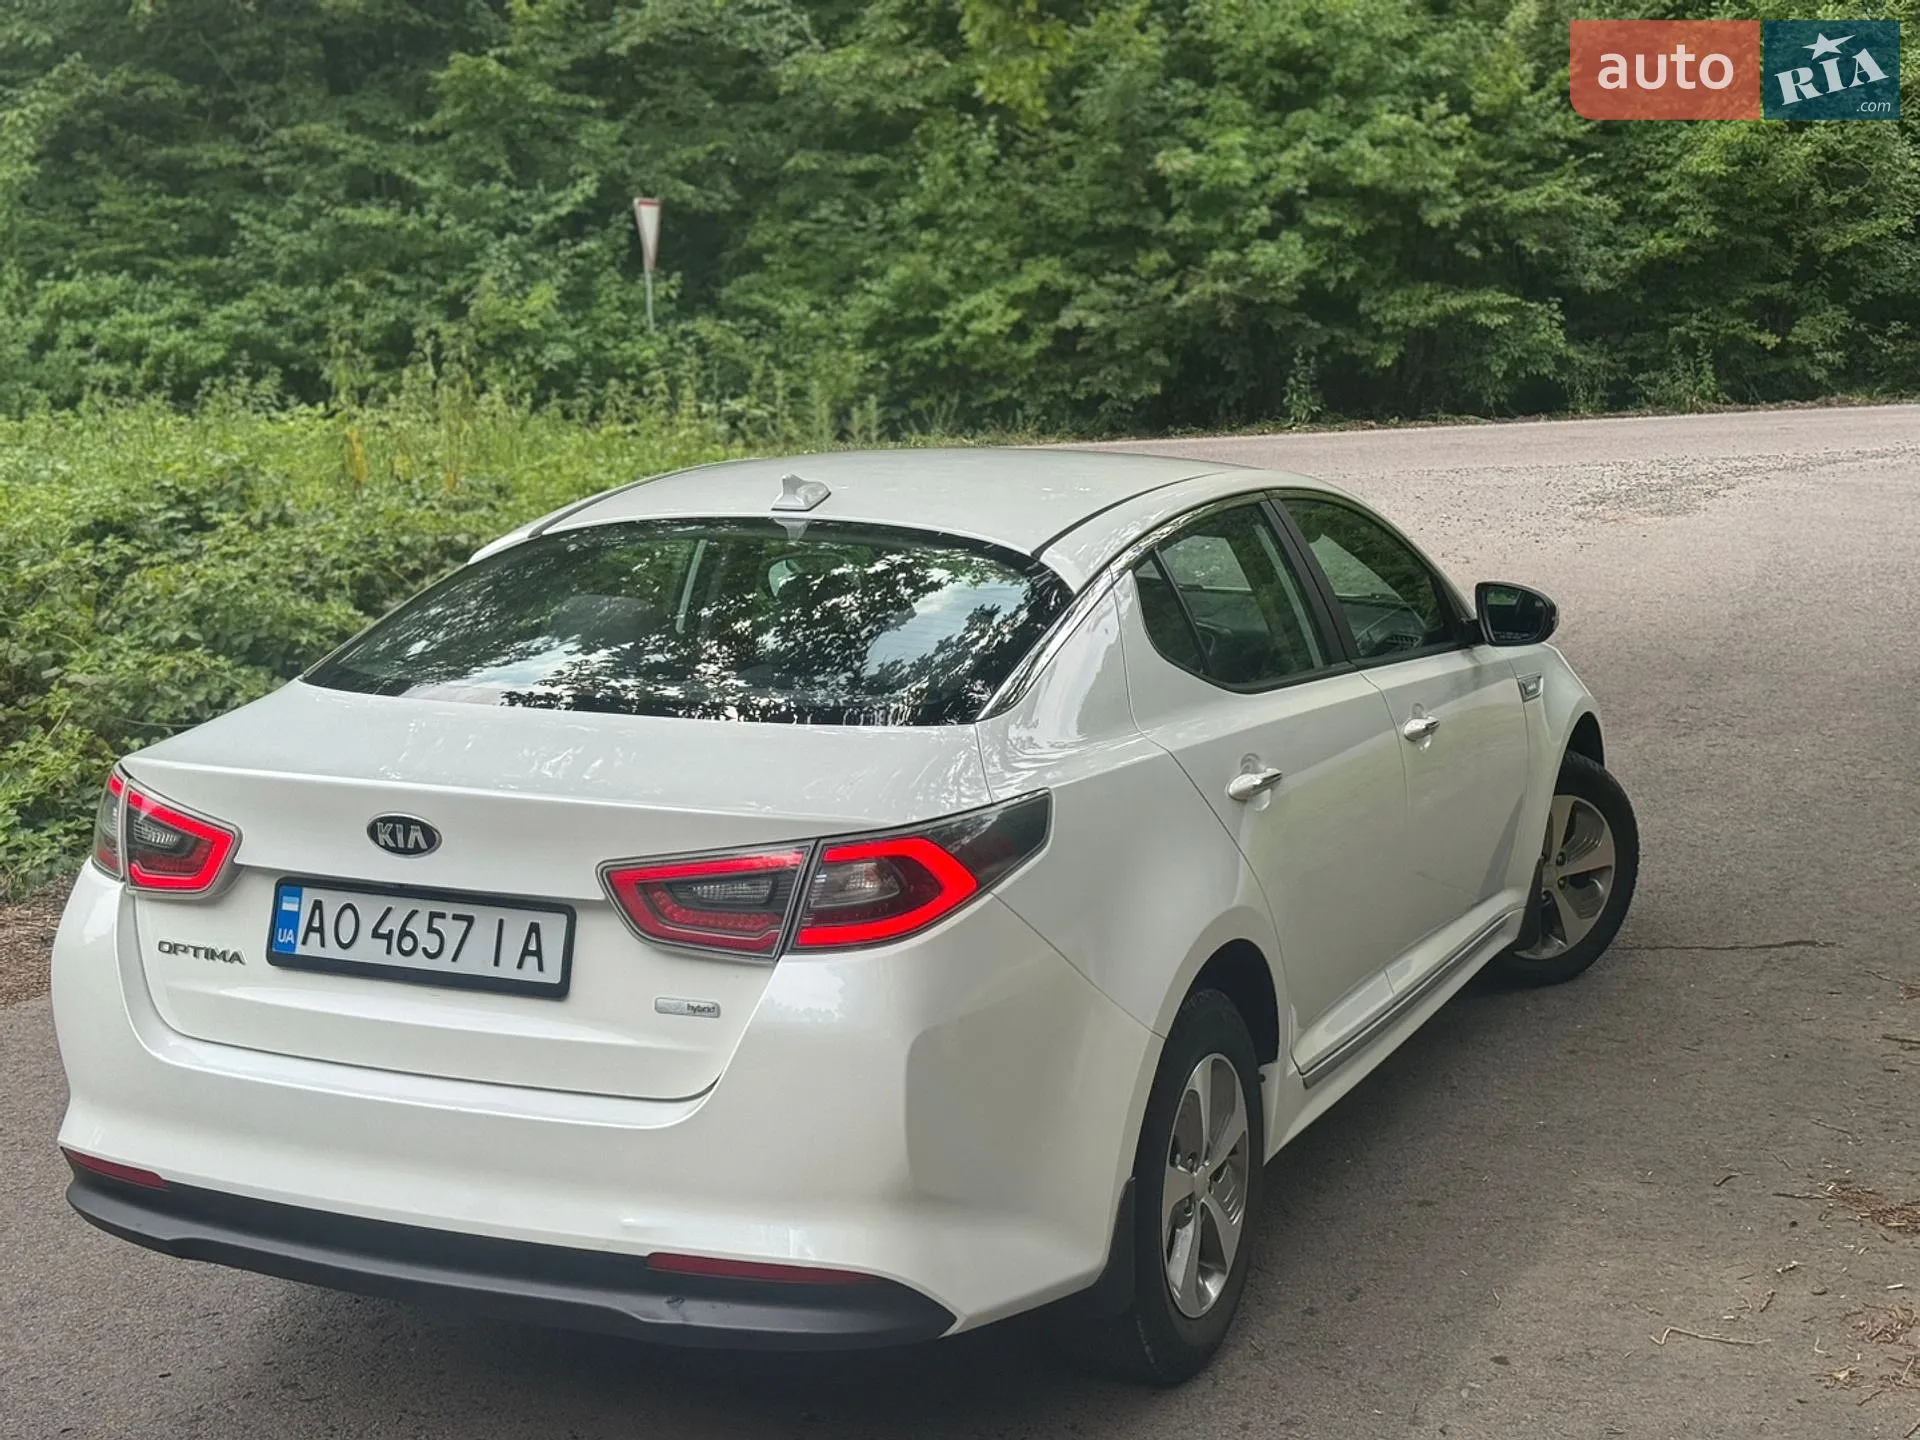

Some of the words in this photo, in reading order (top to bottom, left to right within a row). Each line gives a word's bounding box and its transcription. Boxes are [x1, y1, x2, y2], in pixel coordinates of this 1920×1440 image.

[377, 822, 428, 849] KIA
[278, 928, 295, 944] UA
[301, 899, 360, 949] AO
[371, 906, 475, 962] 4657
[493, 918, 544, 972] IA
[158, 940, 246, 965] OPTIMA
[686, 1003, 716, 1014] hybrid
